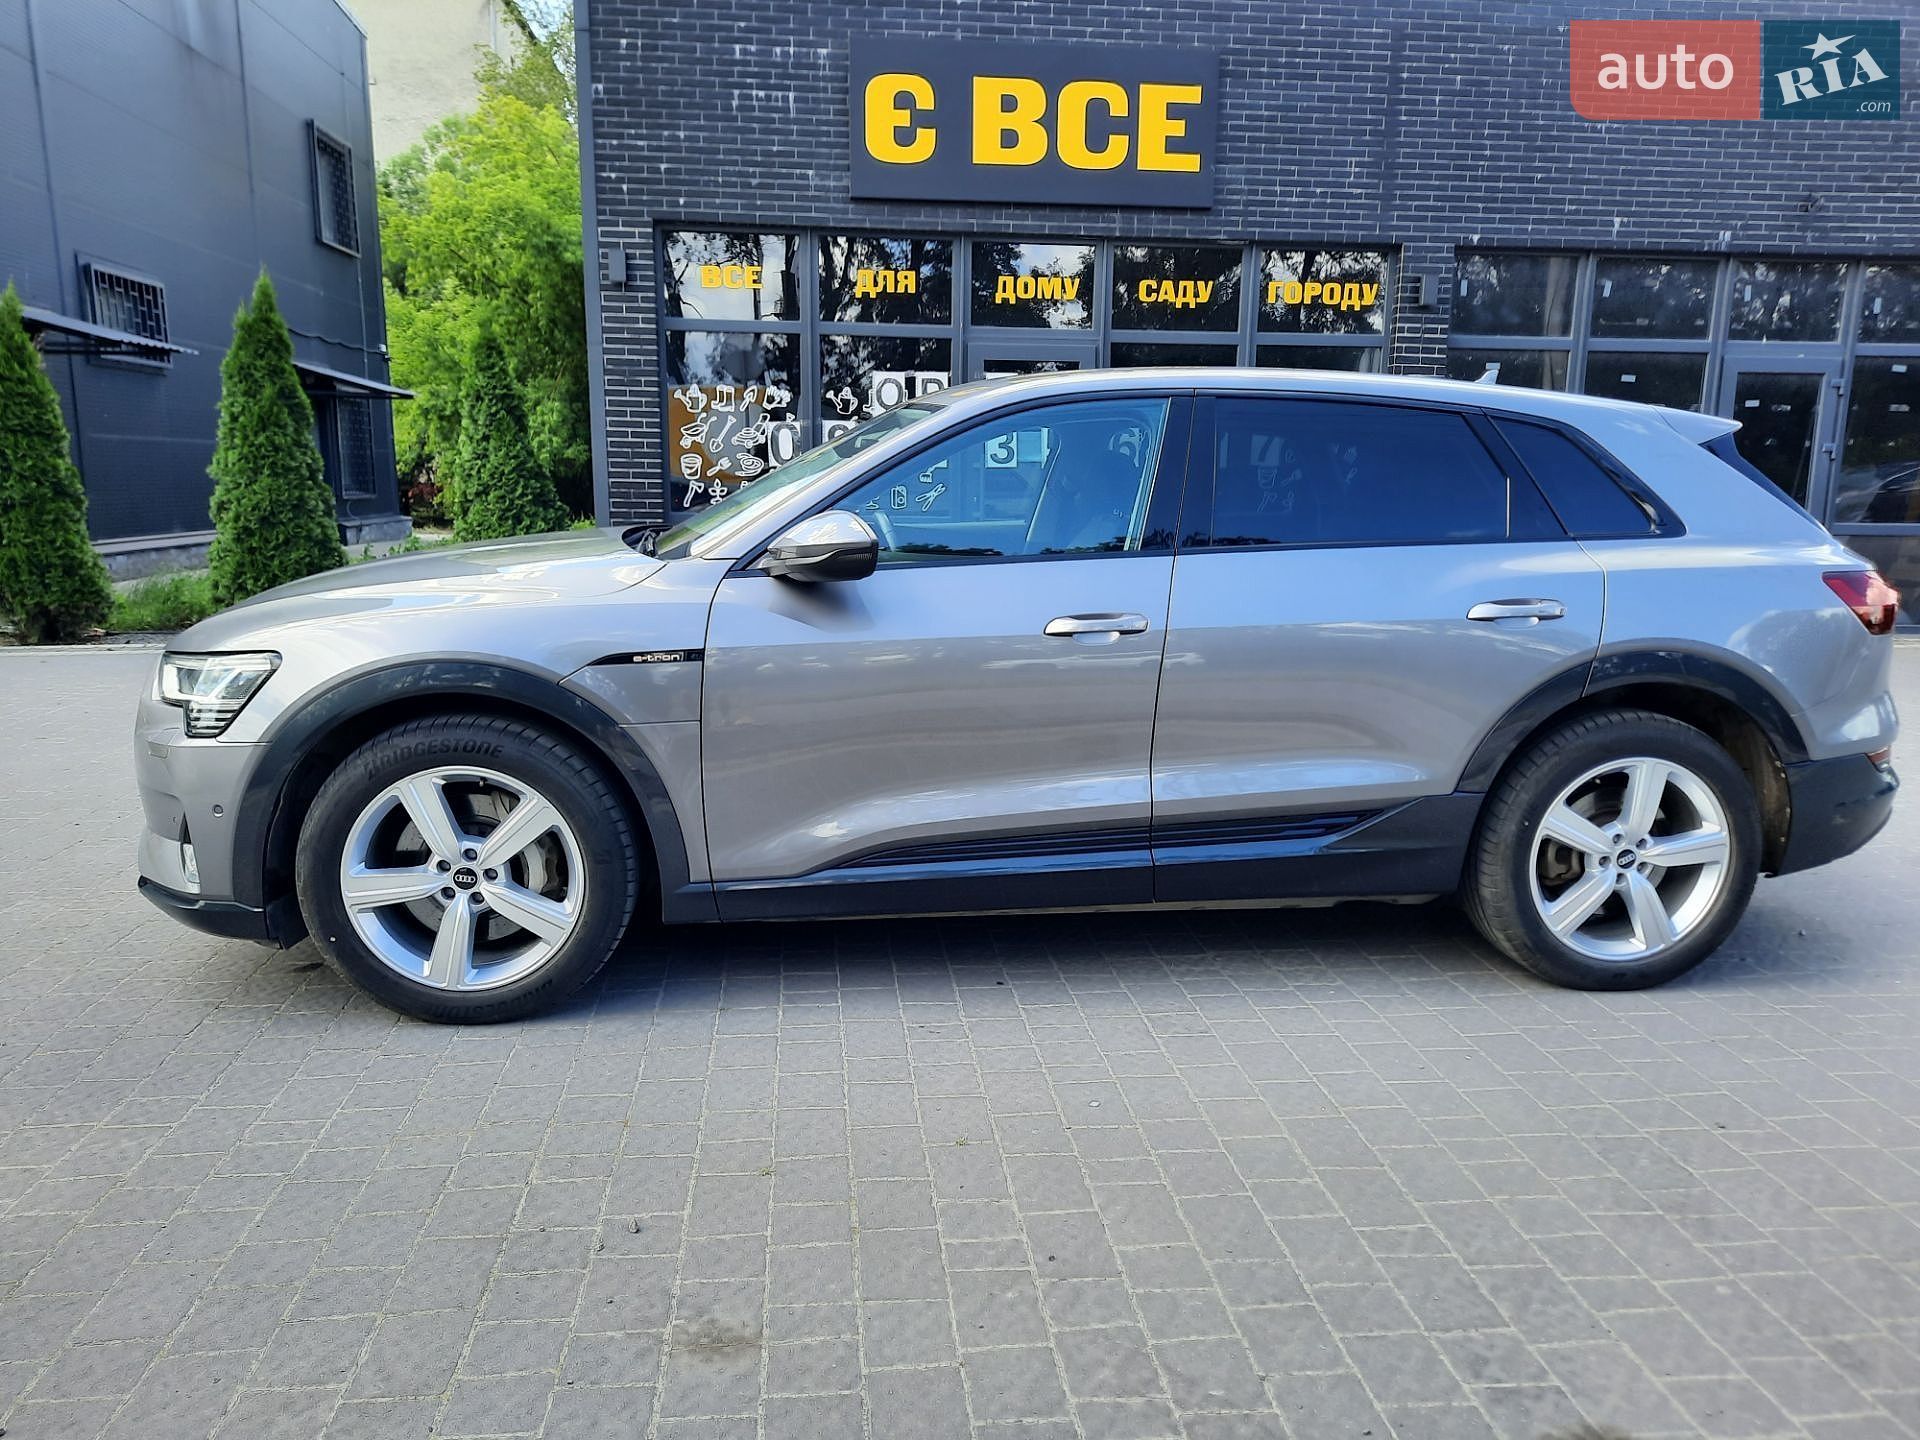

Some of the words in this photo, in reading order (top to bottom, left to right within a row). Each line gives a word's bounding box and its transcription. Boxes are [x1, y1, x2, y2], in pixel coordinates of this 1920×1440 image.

[864, 72, 937, 164] Є
[972, 75, 1203, 173] ВСЕ
[700, 264, 764, 289] ВСЕ
[854, 268, 916, 298] ДЛЯ
[994, 274, 1080, 305] ДОМУ
[1138, 278, 1214, 309] САДУ
[1267, 280, 1379, 311] ГОРОДУ
[633, 653, 680, 662] e-tron
